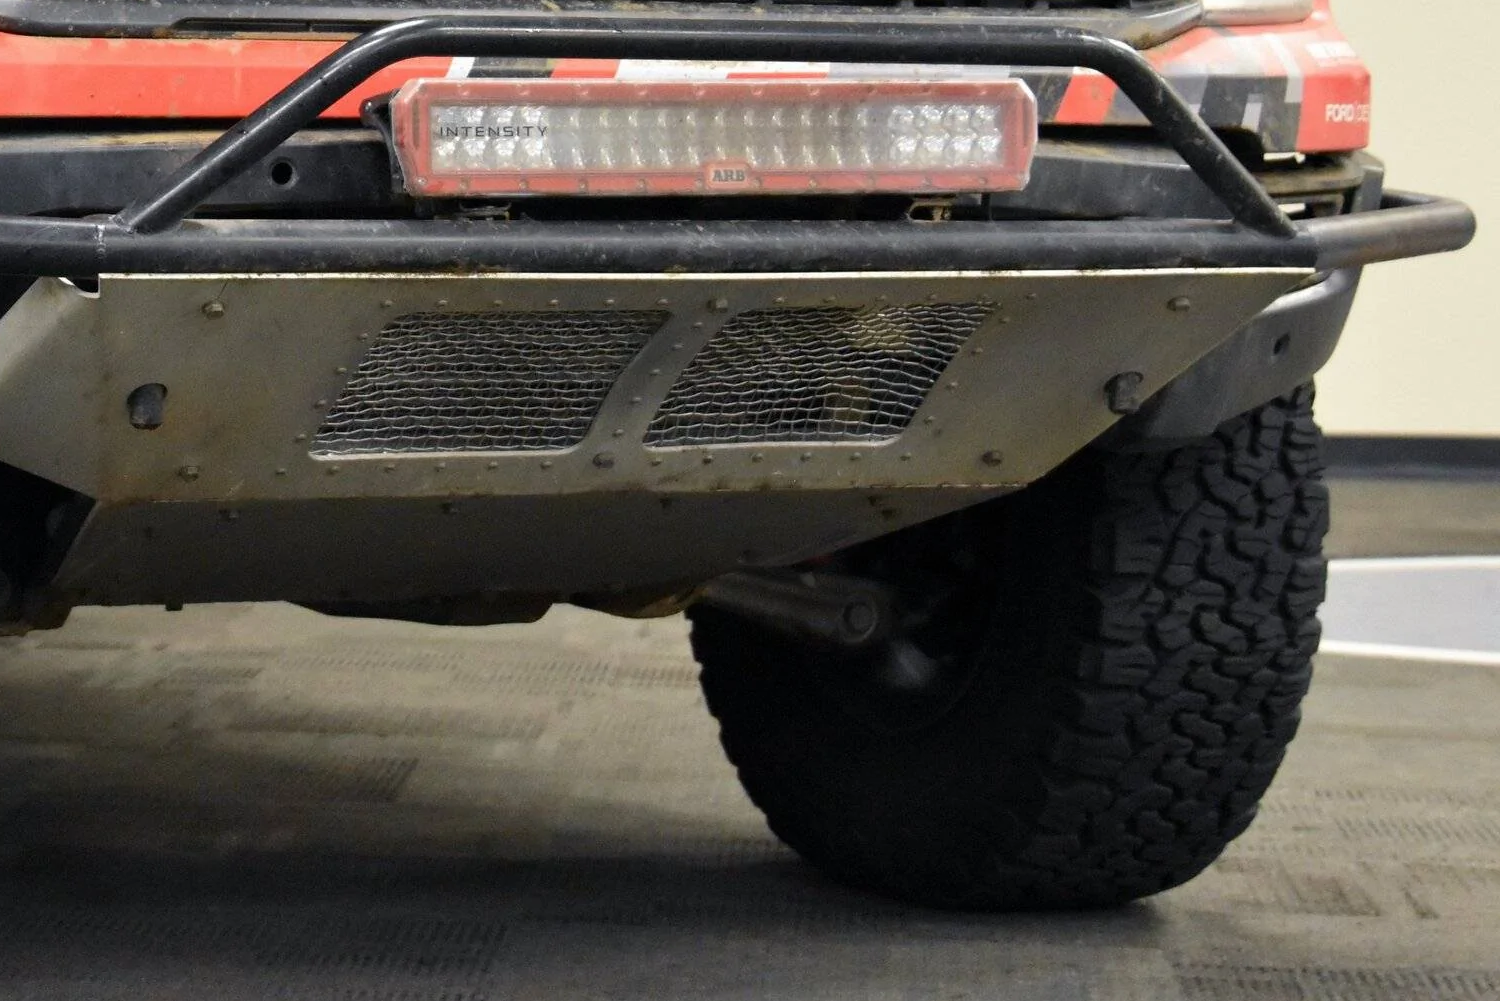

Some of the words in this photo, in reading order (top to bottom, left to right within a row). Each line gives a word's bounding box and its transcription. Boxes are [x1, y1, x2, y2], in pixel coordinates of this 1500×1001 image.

[1325, 103, 1354, 122] FORD
[440, 126, 548, 137] INTENSITY
[712, 169, 746, 182] ARB
